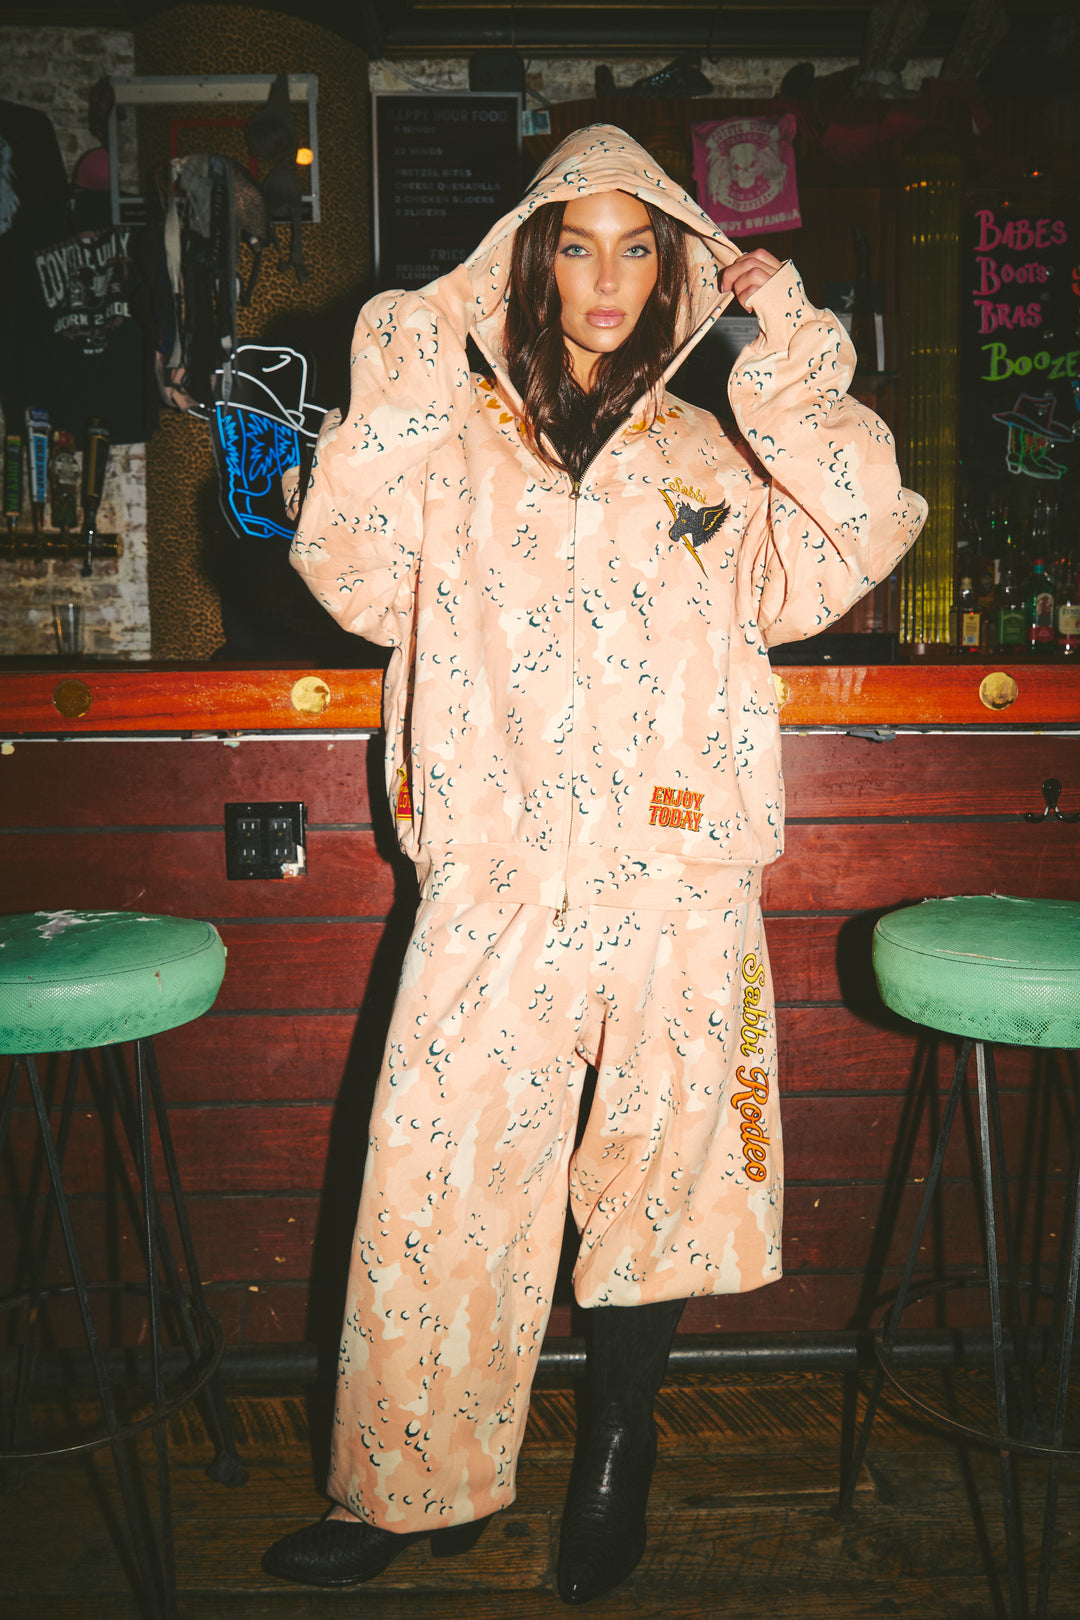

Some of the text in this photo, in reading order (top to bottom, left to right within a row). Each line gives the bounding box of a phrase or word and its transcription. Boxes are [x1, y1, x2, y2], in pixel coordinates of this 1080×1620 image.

[432, 110, 468, 121] HOUR
[472, 110, 508, 122] FOOD
[973, 209, 1068, 251] BABES
[972, 255, 1048, 296] BOOTS
[94, 314, 104, 326] 2
[973, 299, 1043, 334] BRAS
[981, 342, 1080, 382] BOOZE
[668, 477, 708, 505] Sabbi
[650, 785, 705, 811] ENJOY
[648, 804, 704, 832] TODAY
[740, 953, 768, 1057] Sabbi
[730, 1066, 770, 1183] Rodeo
